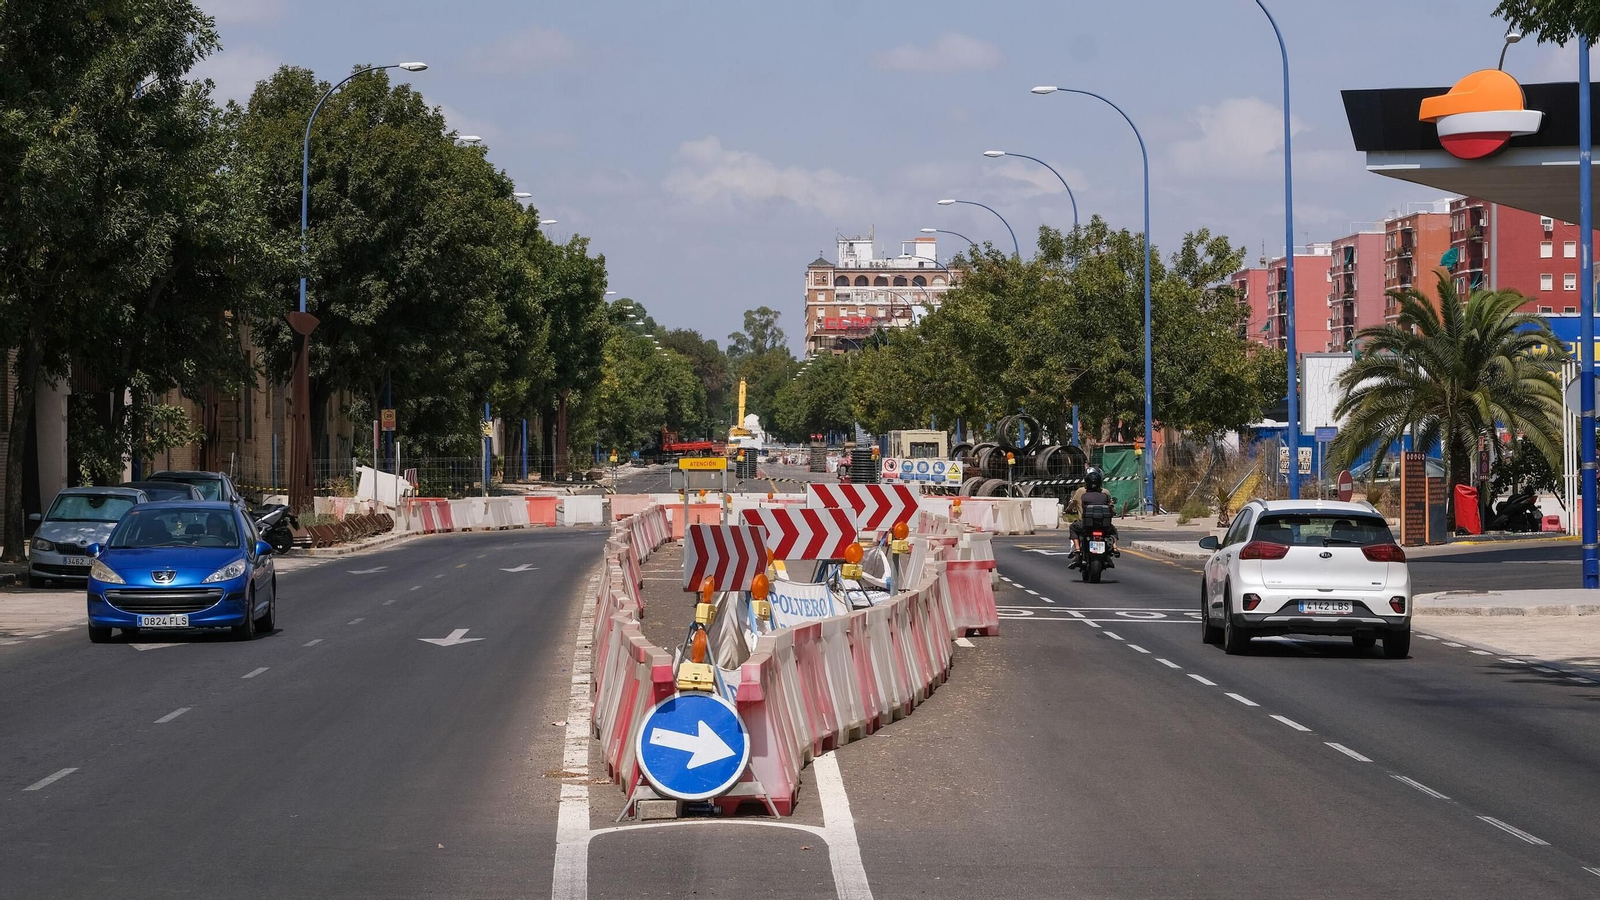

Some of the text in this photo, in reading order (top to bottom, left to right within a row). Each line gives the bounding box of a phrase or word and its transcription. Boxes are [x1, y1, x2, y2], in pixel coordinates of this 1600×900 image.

[68, 558, 84, 566] 3462
[1307, 602, 1350, 611] 4142 LBS
[144, 617, 187, 626] 0824 FLS
